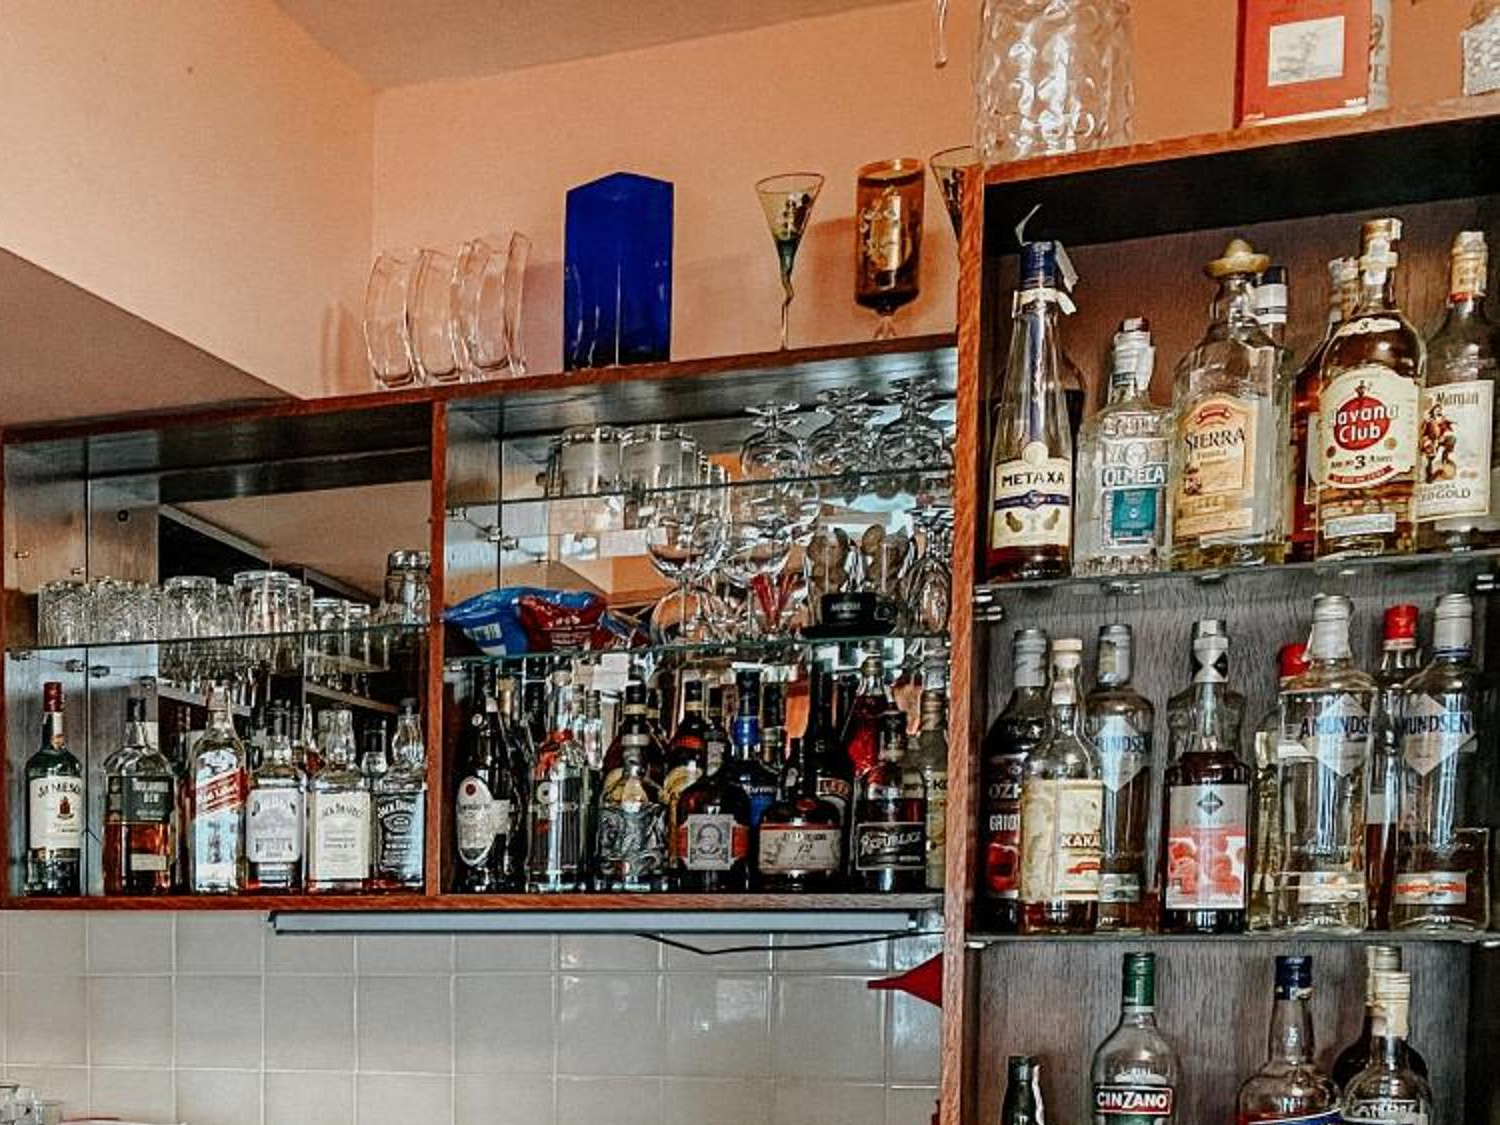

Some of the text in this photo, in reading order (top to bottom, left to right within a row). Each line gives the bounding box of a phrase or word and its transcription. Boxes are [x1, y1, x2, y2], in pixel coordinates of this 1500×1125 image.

[1338, 424, 1381, 443] Club
[1355, 455, 1366, 470] 3
[1002, 471, 1065, 487] METAXA
[1104, 466, 1165, 485] OLMECA
[1097, 1091, 1167, 1109] CINZANO
